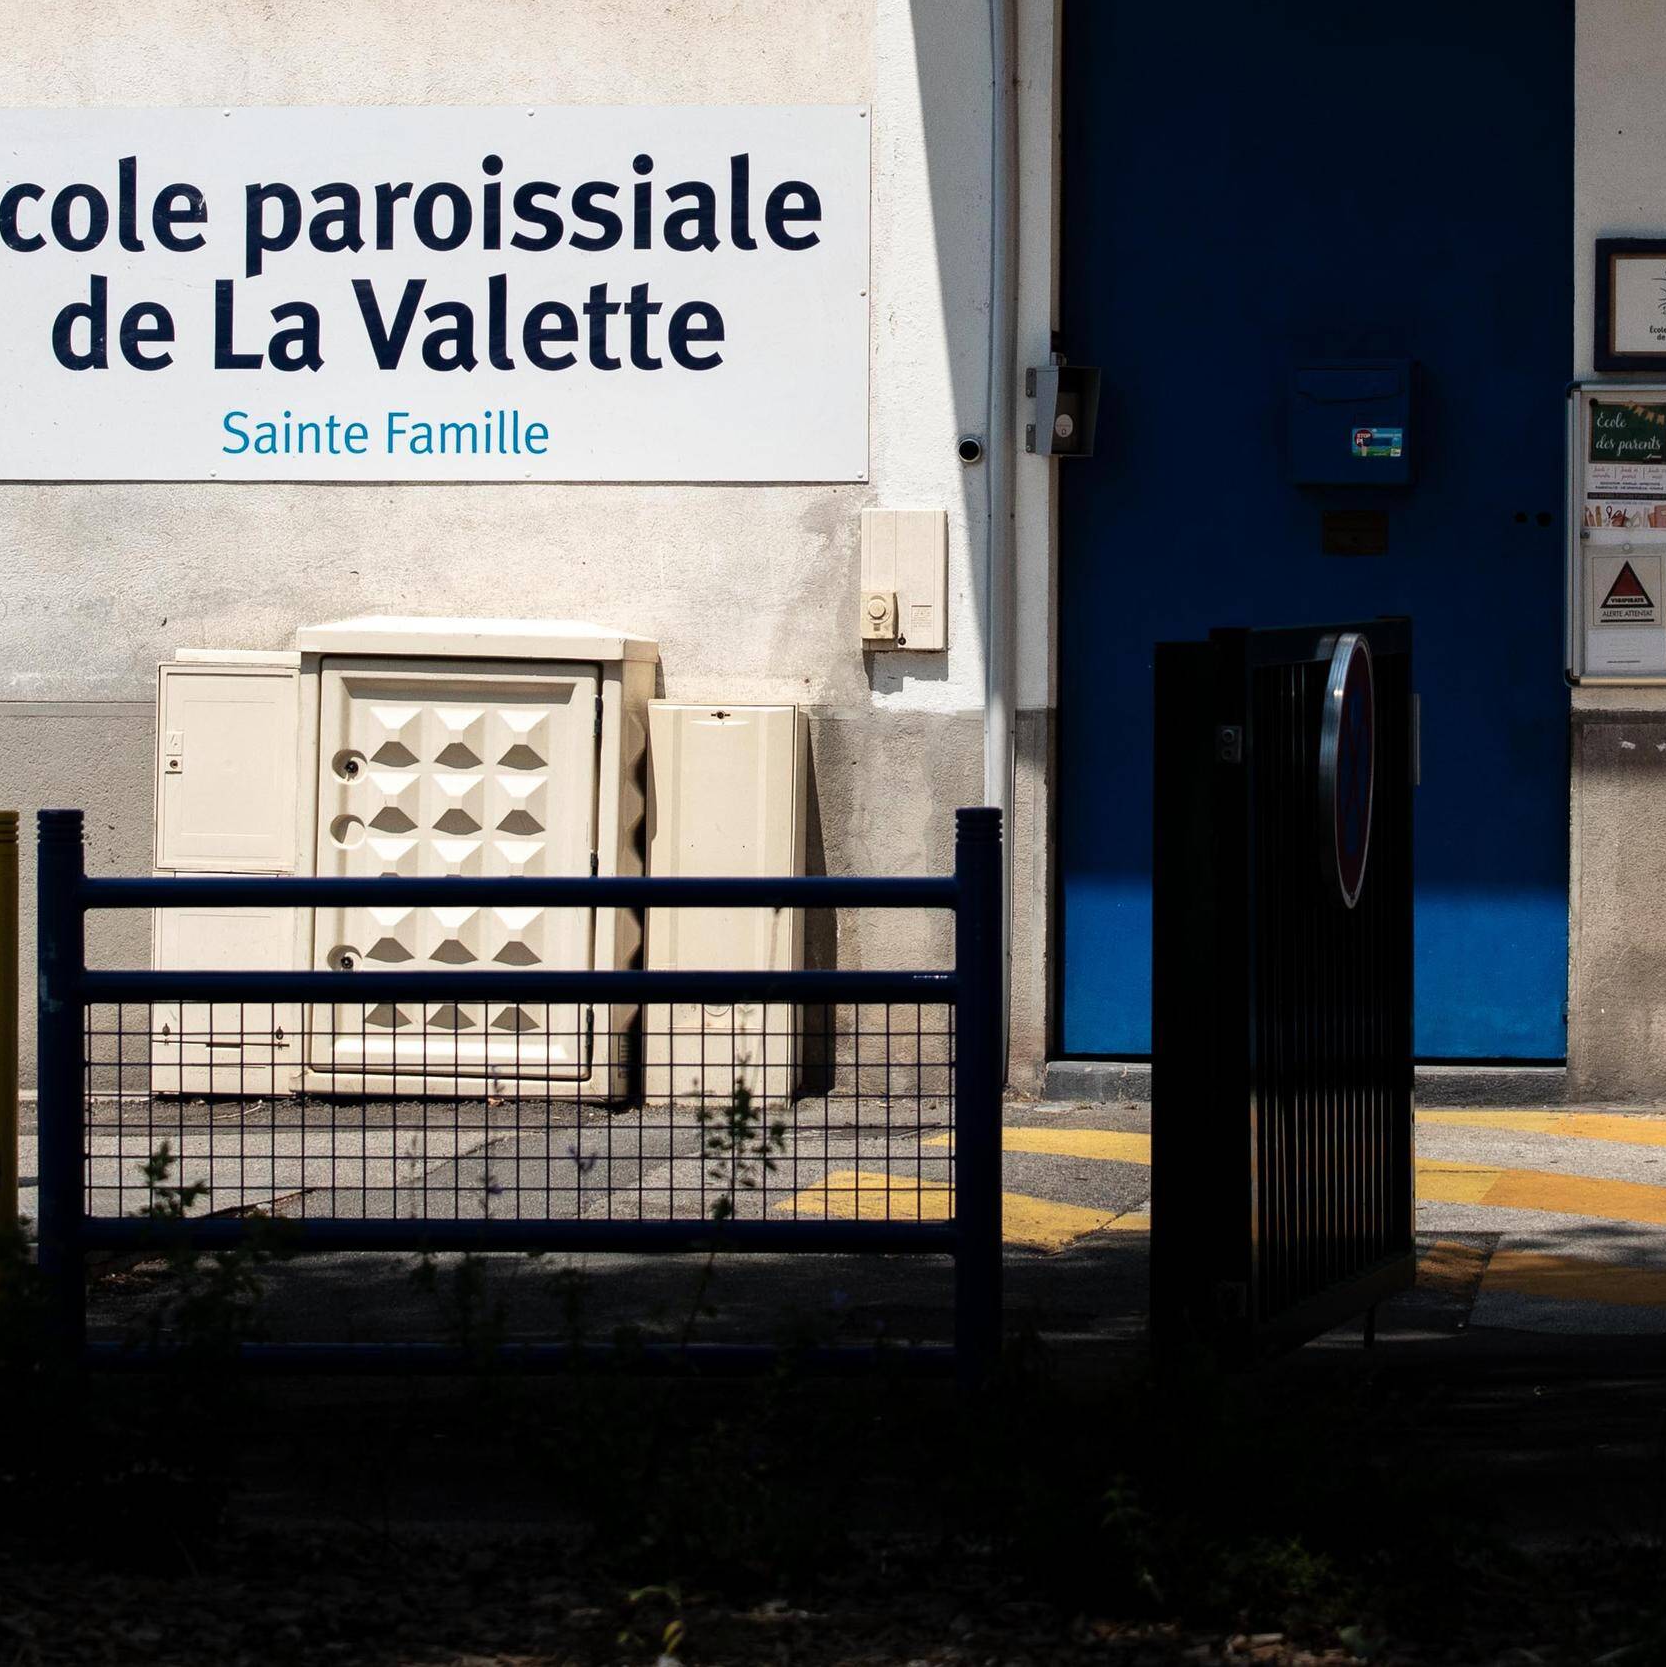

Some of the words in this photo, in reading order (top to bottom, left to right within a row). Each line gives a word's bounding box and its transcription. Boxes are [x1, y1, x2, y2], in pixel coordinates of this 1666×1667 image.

[246, 153, 821, 278] paroissiale
[52, 274, 175, 371] de
[215, 272, 324, 372] La
[351, 274, 724, 372] Valette
[1656, 333, 1666, 341] de
[223, 411, 368, 454] Sainte
[388, 410, 548, 454] Famille
[1595, 434, 1615, 450] des
[1617, 434, 1661, 456] parents
